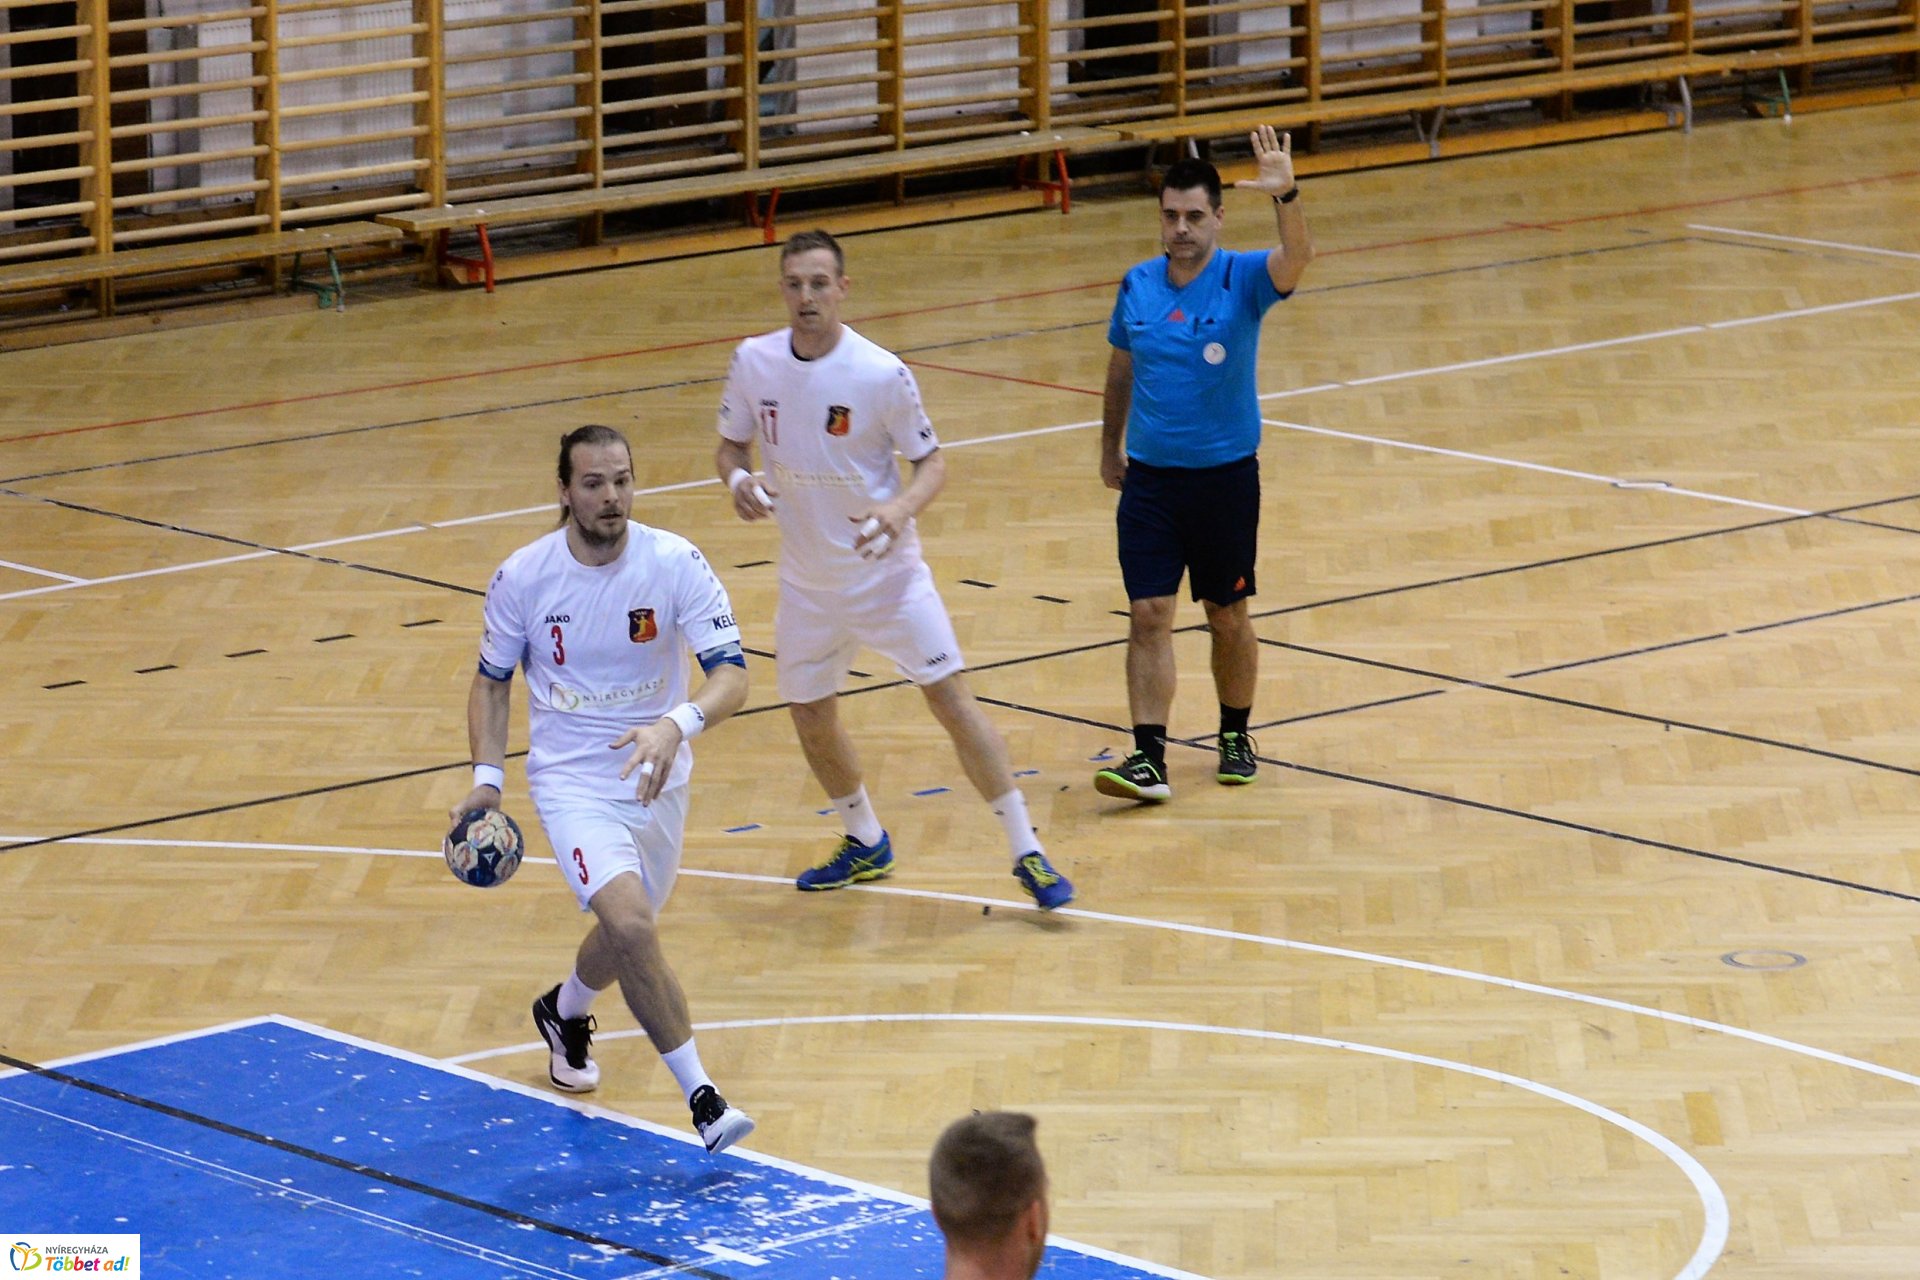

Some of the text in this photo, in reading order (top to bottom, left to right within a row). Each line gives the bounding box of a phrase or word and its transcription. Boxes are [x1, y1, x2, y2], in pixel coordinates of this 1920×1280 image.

[544, 614, 570, 624] JAKO
[551, 624, 566, 666] 3
[573, 847, 589, 886] 3
